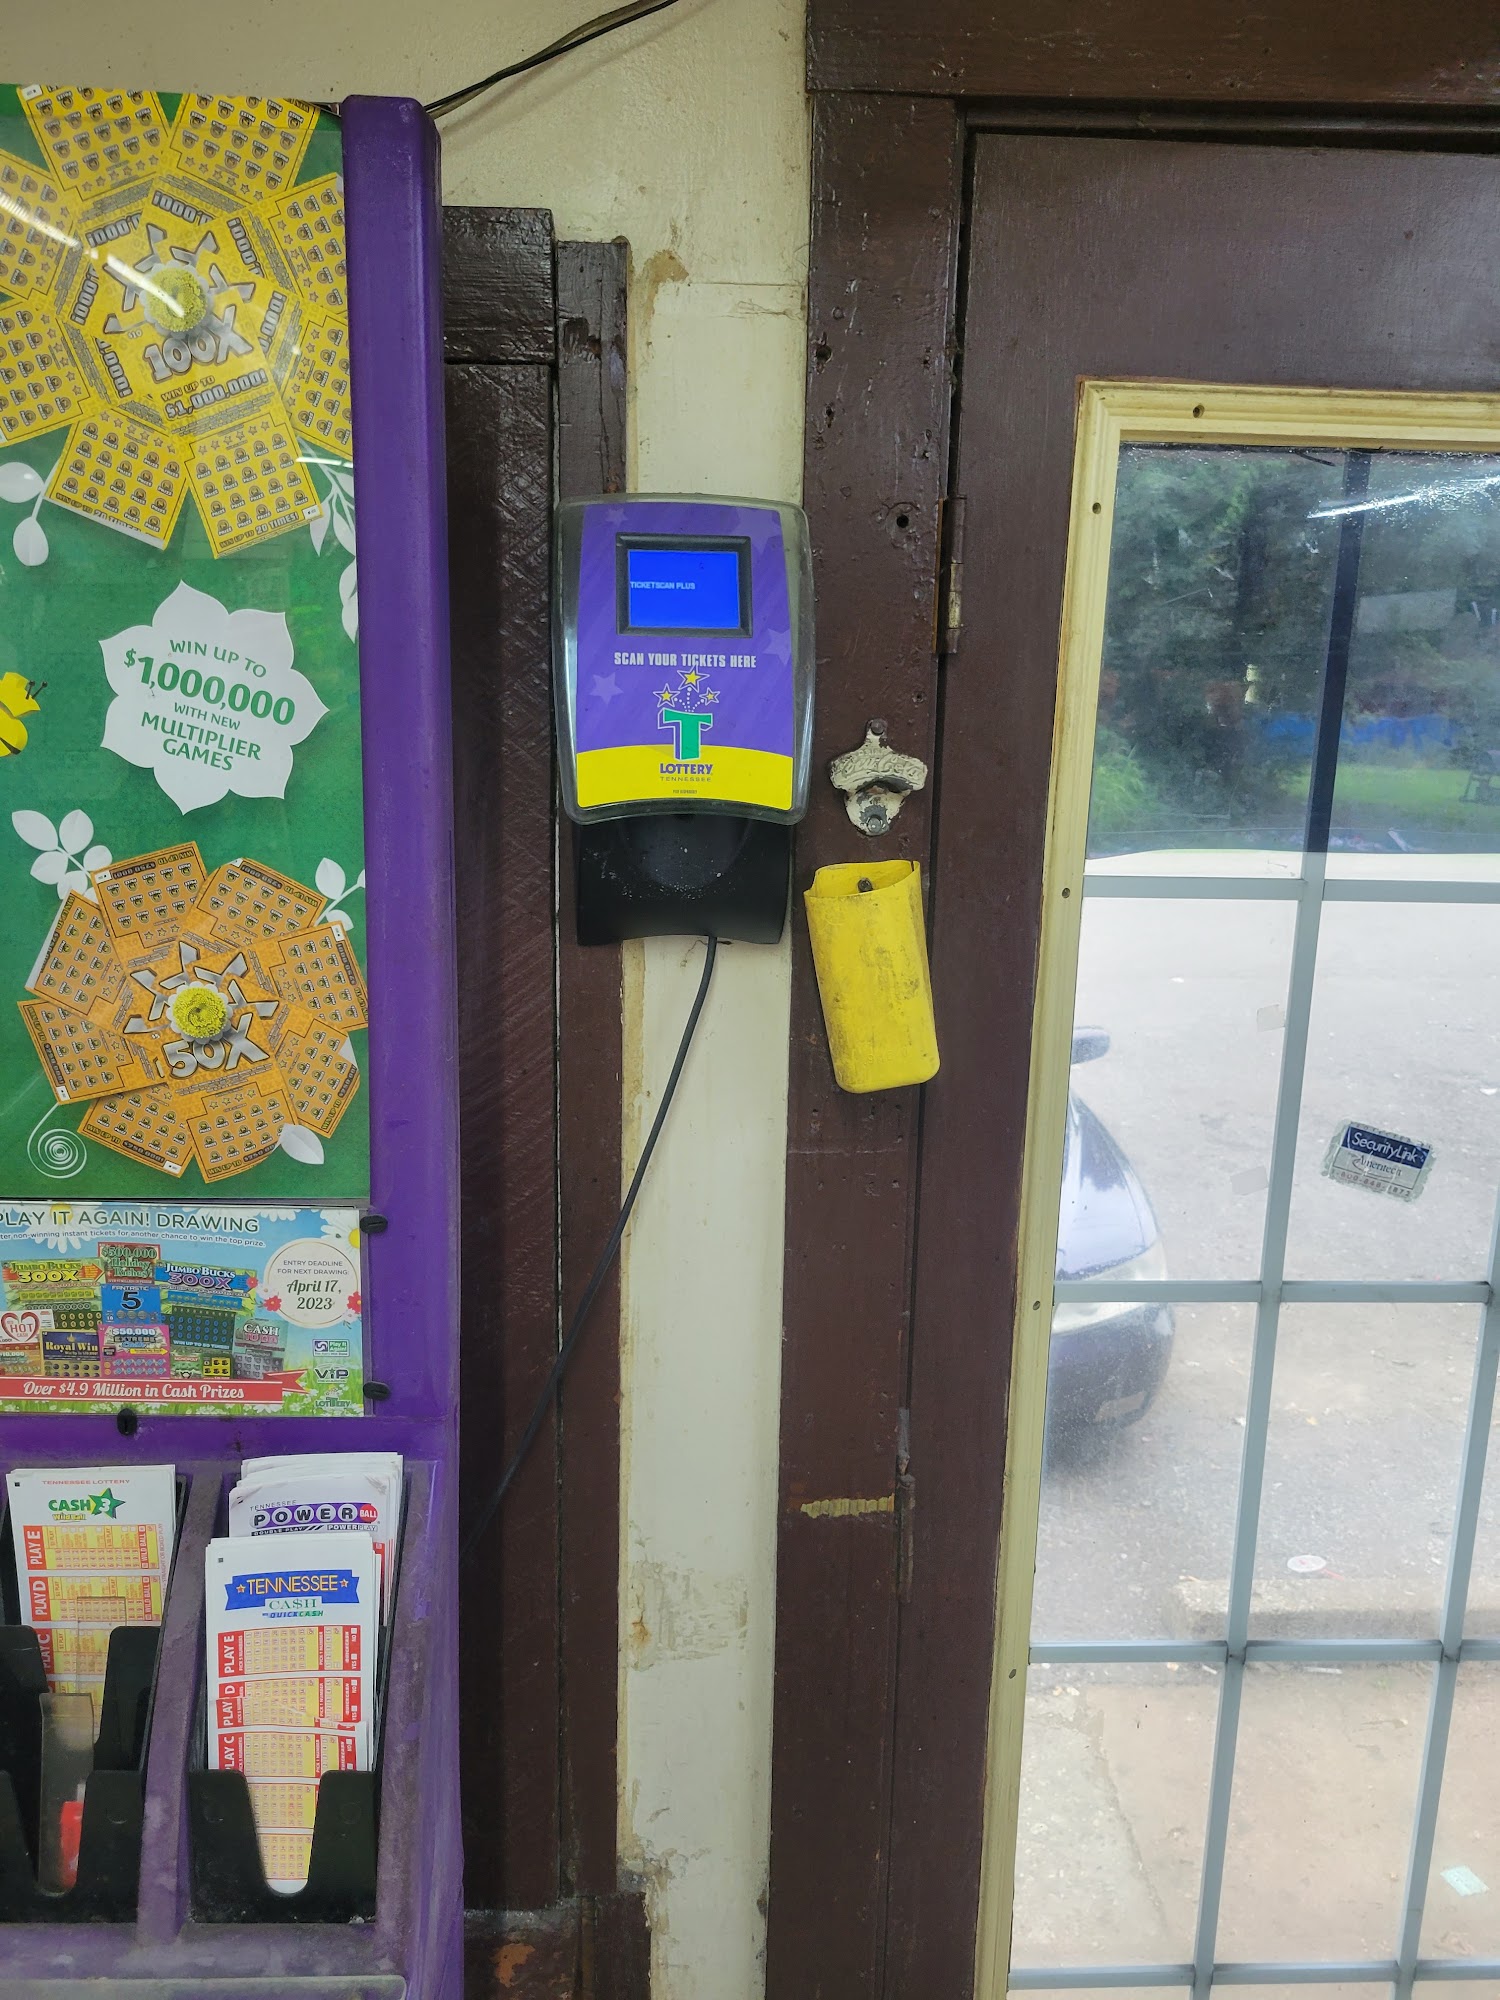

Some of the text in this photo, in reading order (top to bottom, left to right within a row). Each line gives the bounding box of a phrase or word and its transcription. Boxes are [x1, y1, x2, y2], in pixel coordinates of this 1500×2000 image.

[161, 375, 215, 401] WIN UP TO
[164, 367, 269, 419] $1,000,000!
[255, 523, 268, 534] 20
[269, 512, 298, 529] TIMES!
[630, 581, 695, 590] TICKETSCAN PLUS
[170, 640, 266, 677] WIN UP TO
[614, 652, 757, 668] SCAN YOUR TICKETS HERE
[124, 648, 295, 725] $1,000,000
[174, 702, 240, 730] WITH NEW
[141, 711, 260, 760] MULTIPLIER
[162, 738, 233, 770] GAMES
[660, 763, 714, 775] LOTTERY
[162, 1012, 271, 1081] 50X
[1351, 1132, 1417, 1163] SecurityLink
[53, 1211, 70, 1225] IT
[78, 1211, 150, 1227] AGAIN!
[158, 1213, 259, 1233] DRAWING
[13, 1231, 60, 1239] non-winning
[130, 1230, 158, 1238] another
[229, 1237, 243, 1246] top
[244, 1239, 266, 1247] prize.
[18, 1270, 80, 1284] 300X
[165, 1263, 200, 1275] JUMBO
[201, 1266, 236, 1279] BUCKS
[168, 1272, 232, 1290] 300X
[287, 1279, 341, 1295] April 17,
[121, 1291, 142, 1310] 5
[297, 1297, 333, 1310] 2023
[10, 1323, 34, 1333] HOT
[112, 1327, 155, 1336] $50,000
[244, 1324, 280, 1337] CASH
[45, 1342, 75, 1353] Royal
[77, 1342, 98, 1352] Win
[23, 1382, 245, 1399] Over $4.9 Million in Cash Prizes
[48, 1498, 111, 1512] CASH 3
[250, 1500, 297, 1512] TENNESSEE
[254, 1508, 378, 1526] POWER BALL
[27, 1530, 43, 1565] PLAY E
[139, 1532, 149, 1561] WILD BALL
[247, 1575, 339, 1595] TENNESSEE
[33, 1581, 48, 1616] PLAY D
[269, 1598, 316, 1611] CA$H
[270, 1610, 324, 1619] QUICKCASH
[38, 1633, 51, 1643] C
[223, 1635, 236, 1674] PLAY E
[222, 1685, 235, 1727] PLAY D
[223, 1735, 235, 1769] LAY C
